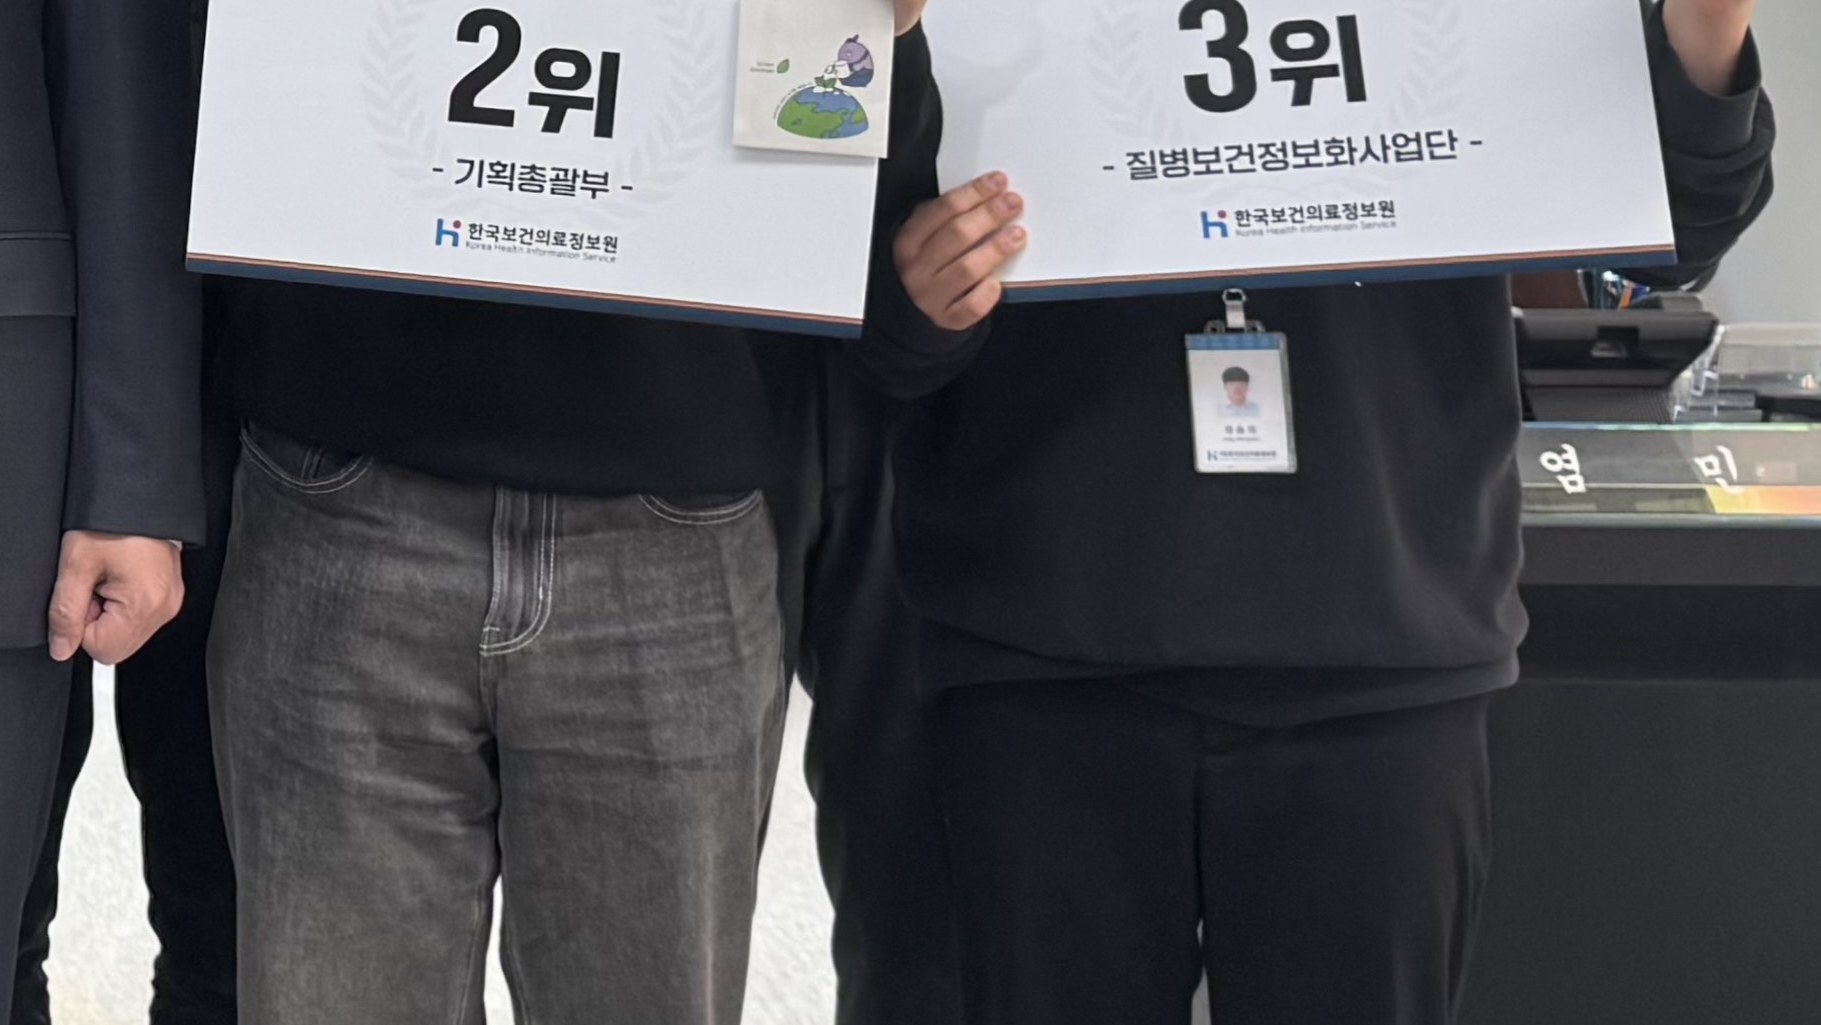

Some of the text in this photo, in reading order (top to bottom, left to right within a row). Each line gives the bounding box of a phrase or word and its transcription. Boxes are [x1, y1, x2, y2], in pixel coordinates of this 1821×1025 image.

[447, 8, 621, 140] 2위
[1126, 129, 1459, 182] 질병보건정보화사업단
[454, 158, 610, 200] 기획총괄부
[1235, 199, 1396, 228] 한국보건의료정보원
[465, 241, 493, 251] Korea
[582, 252, 617, 264] Service
[468, 222, 619, 254] 한국보건의료정보원
[1539, 443, 1587, 494] 염
